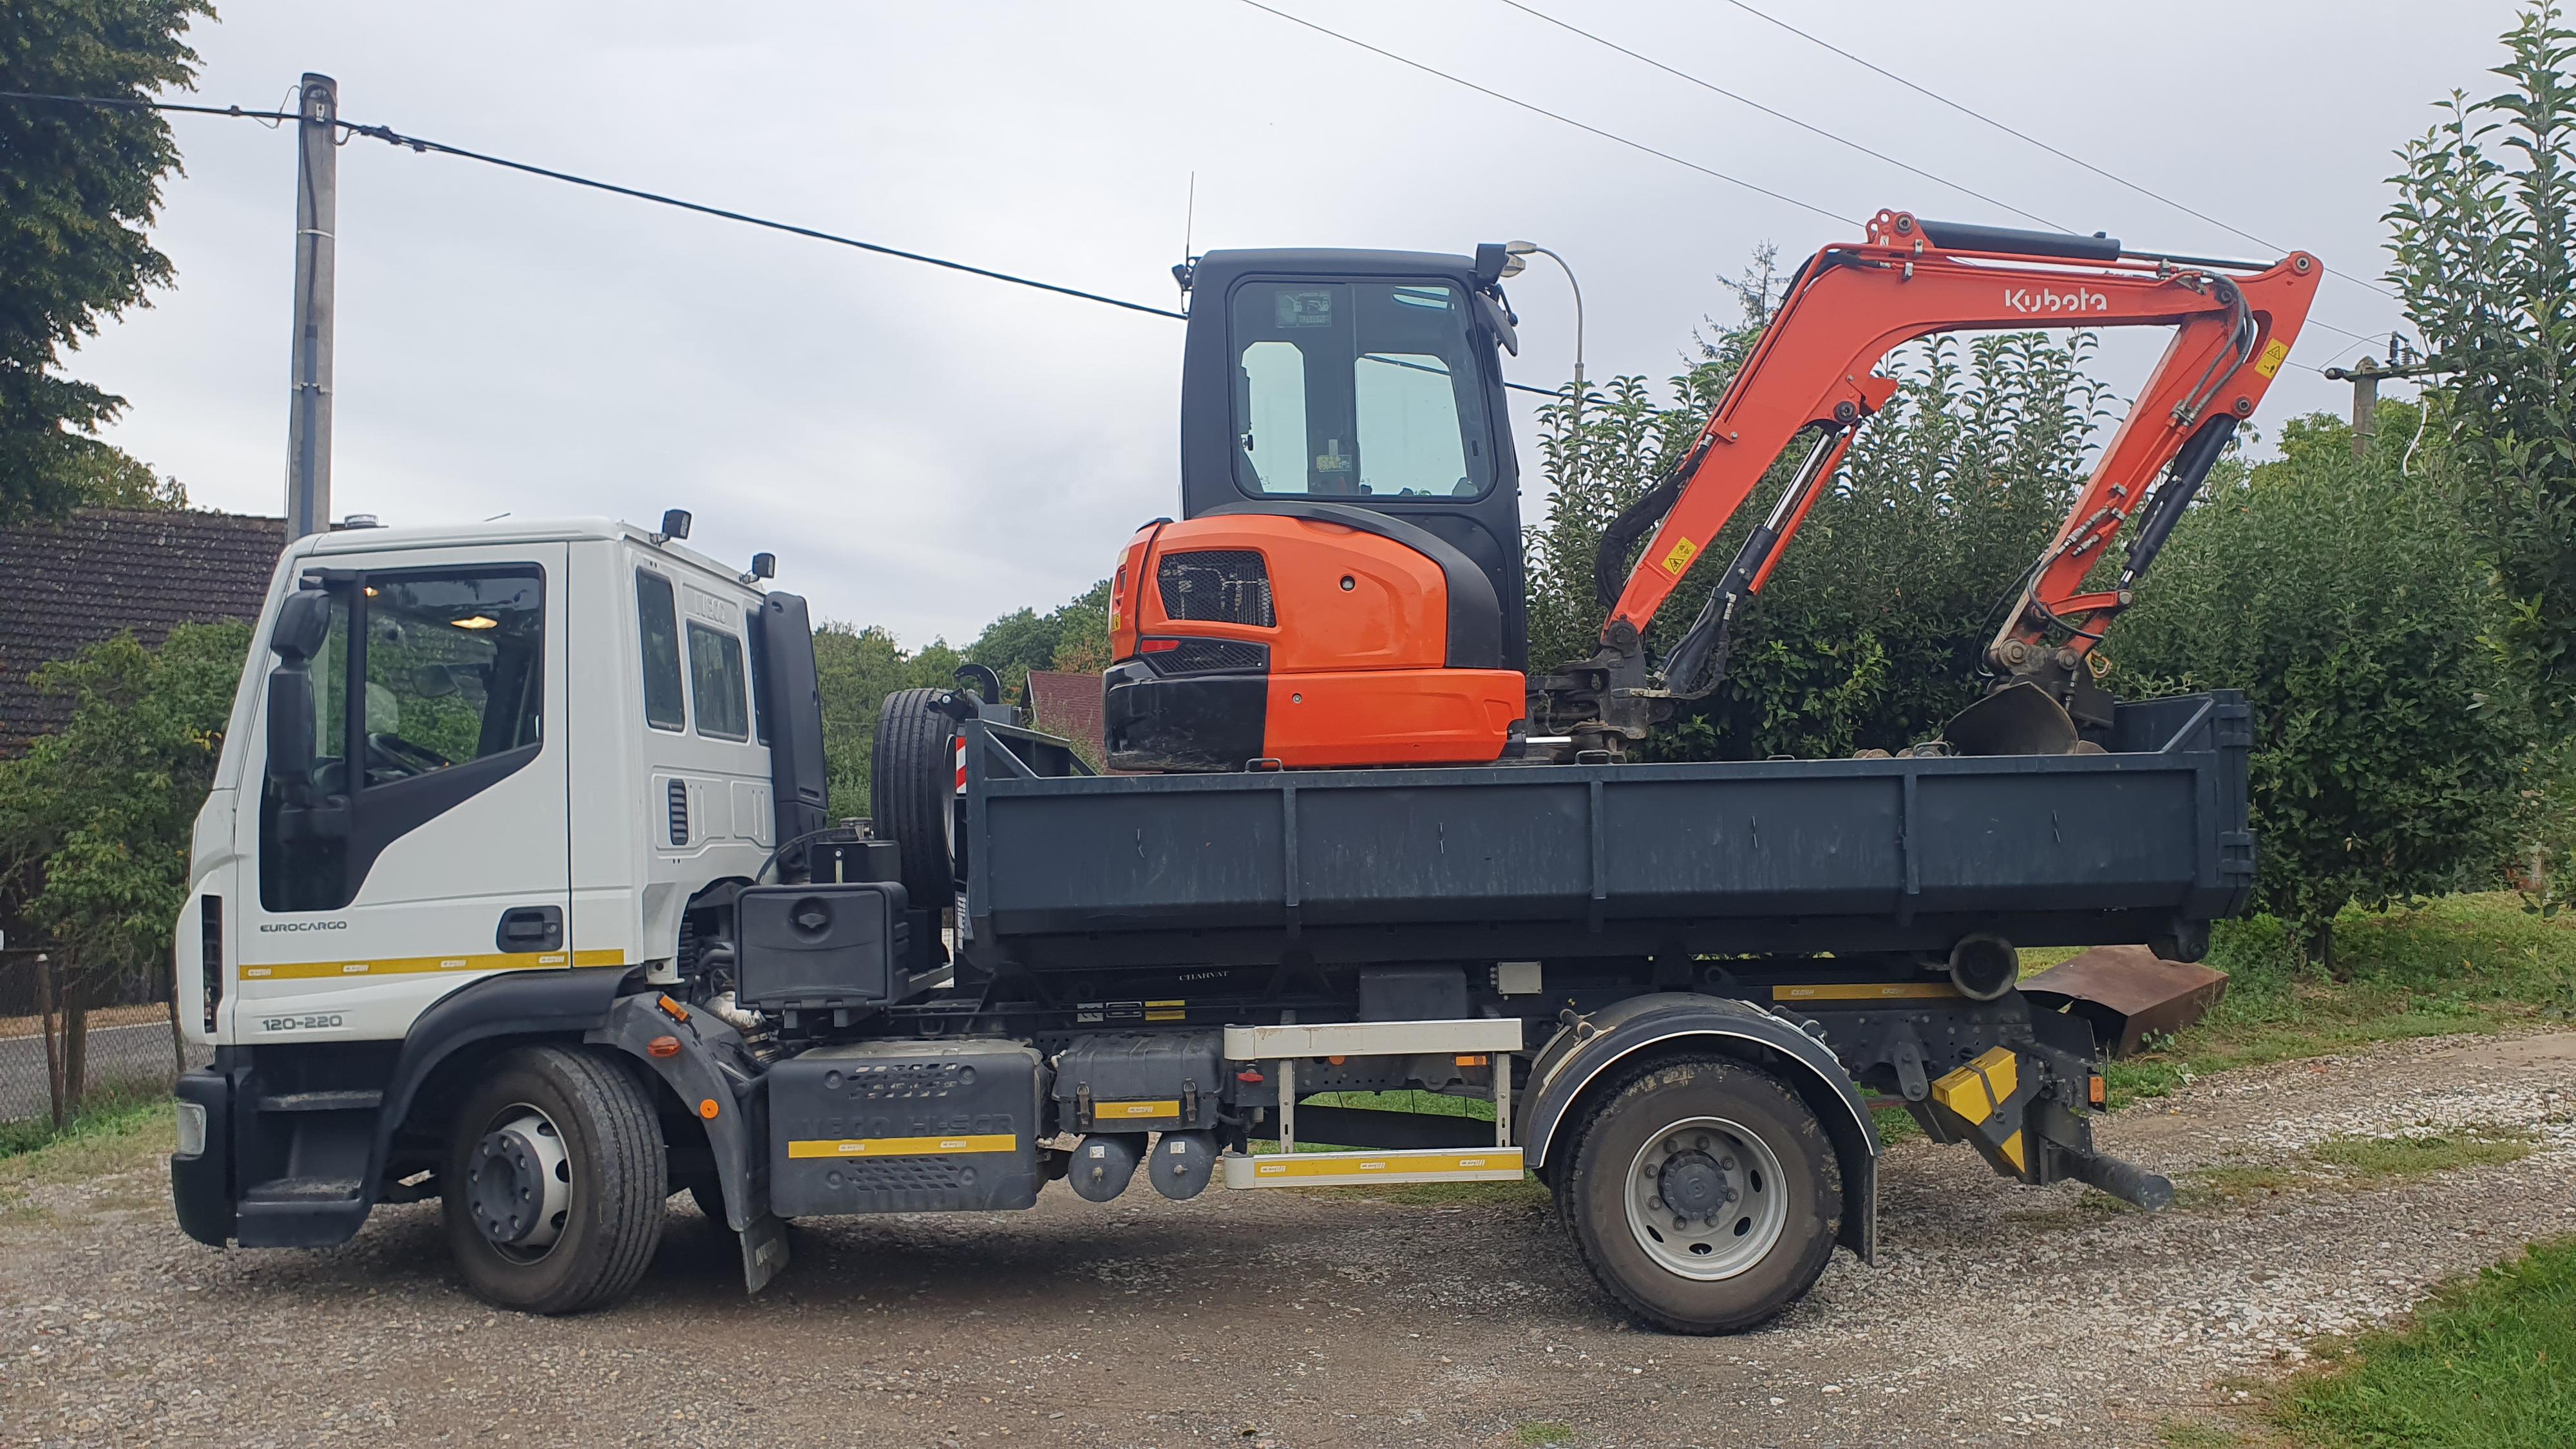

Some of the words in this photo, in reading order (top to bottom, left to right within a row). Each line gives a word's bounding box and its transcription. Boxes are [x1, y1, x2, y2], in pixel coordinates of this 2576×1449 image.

[2005, 287, 2107, 313] Kubota
[260, 921, 347, 932] EUROCARGO
[263, 1015, 343, 1030] 120-220
[907, 1113, 1016, 1135] HI-SCR
